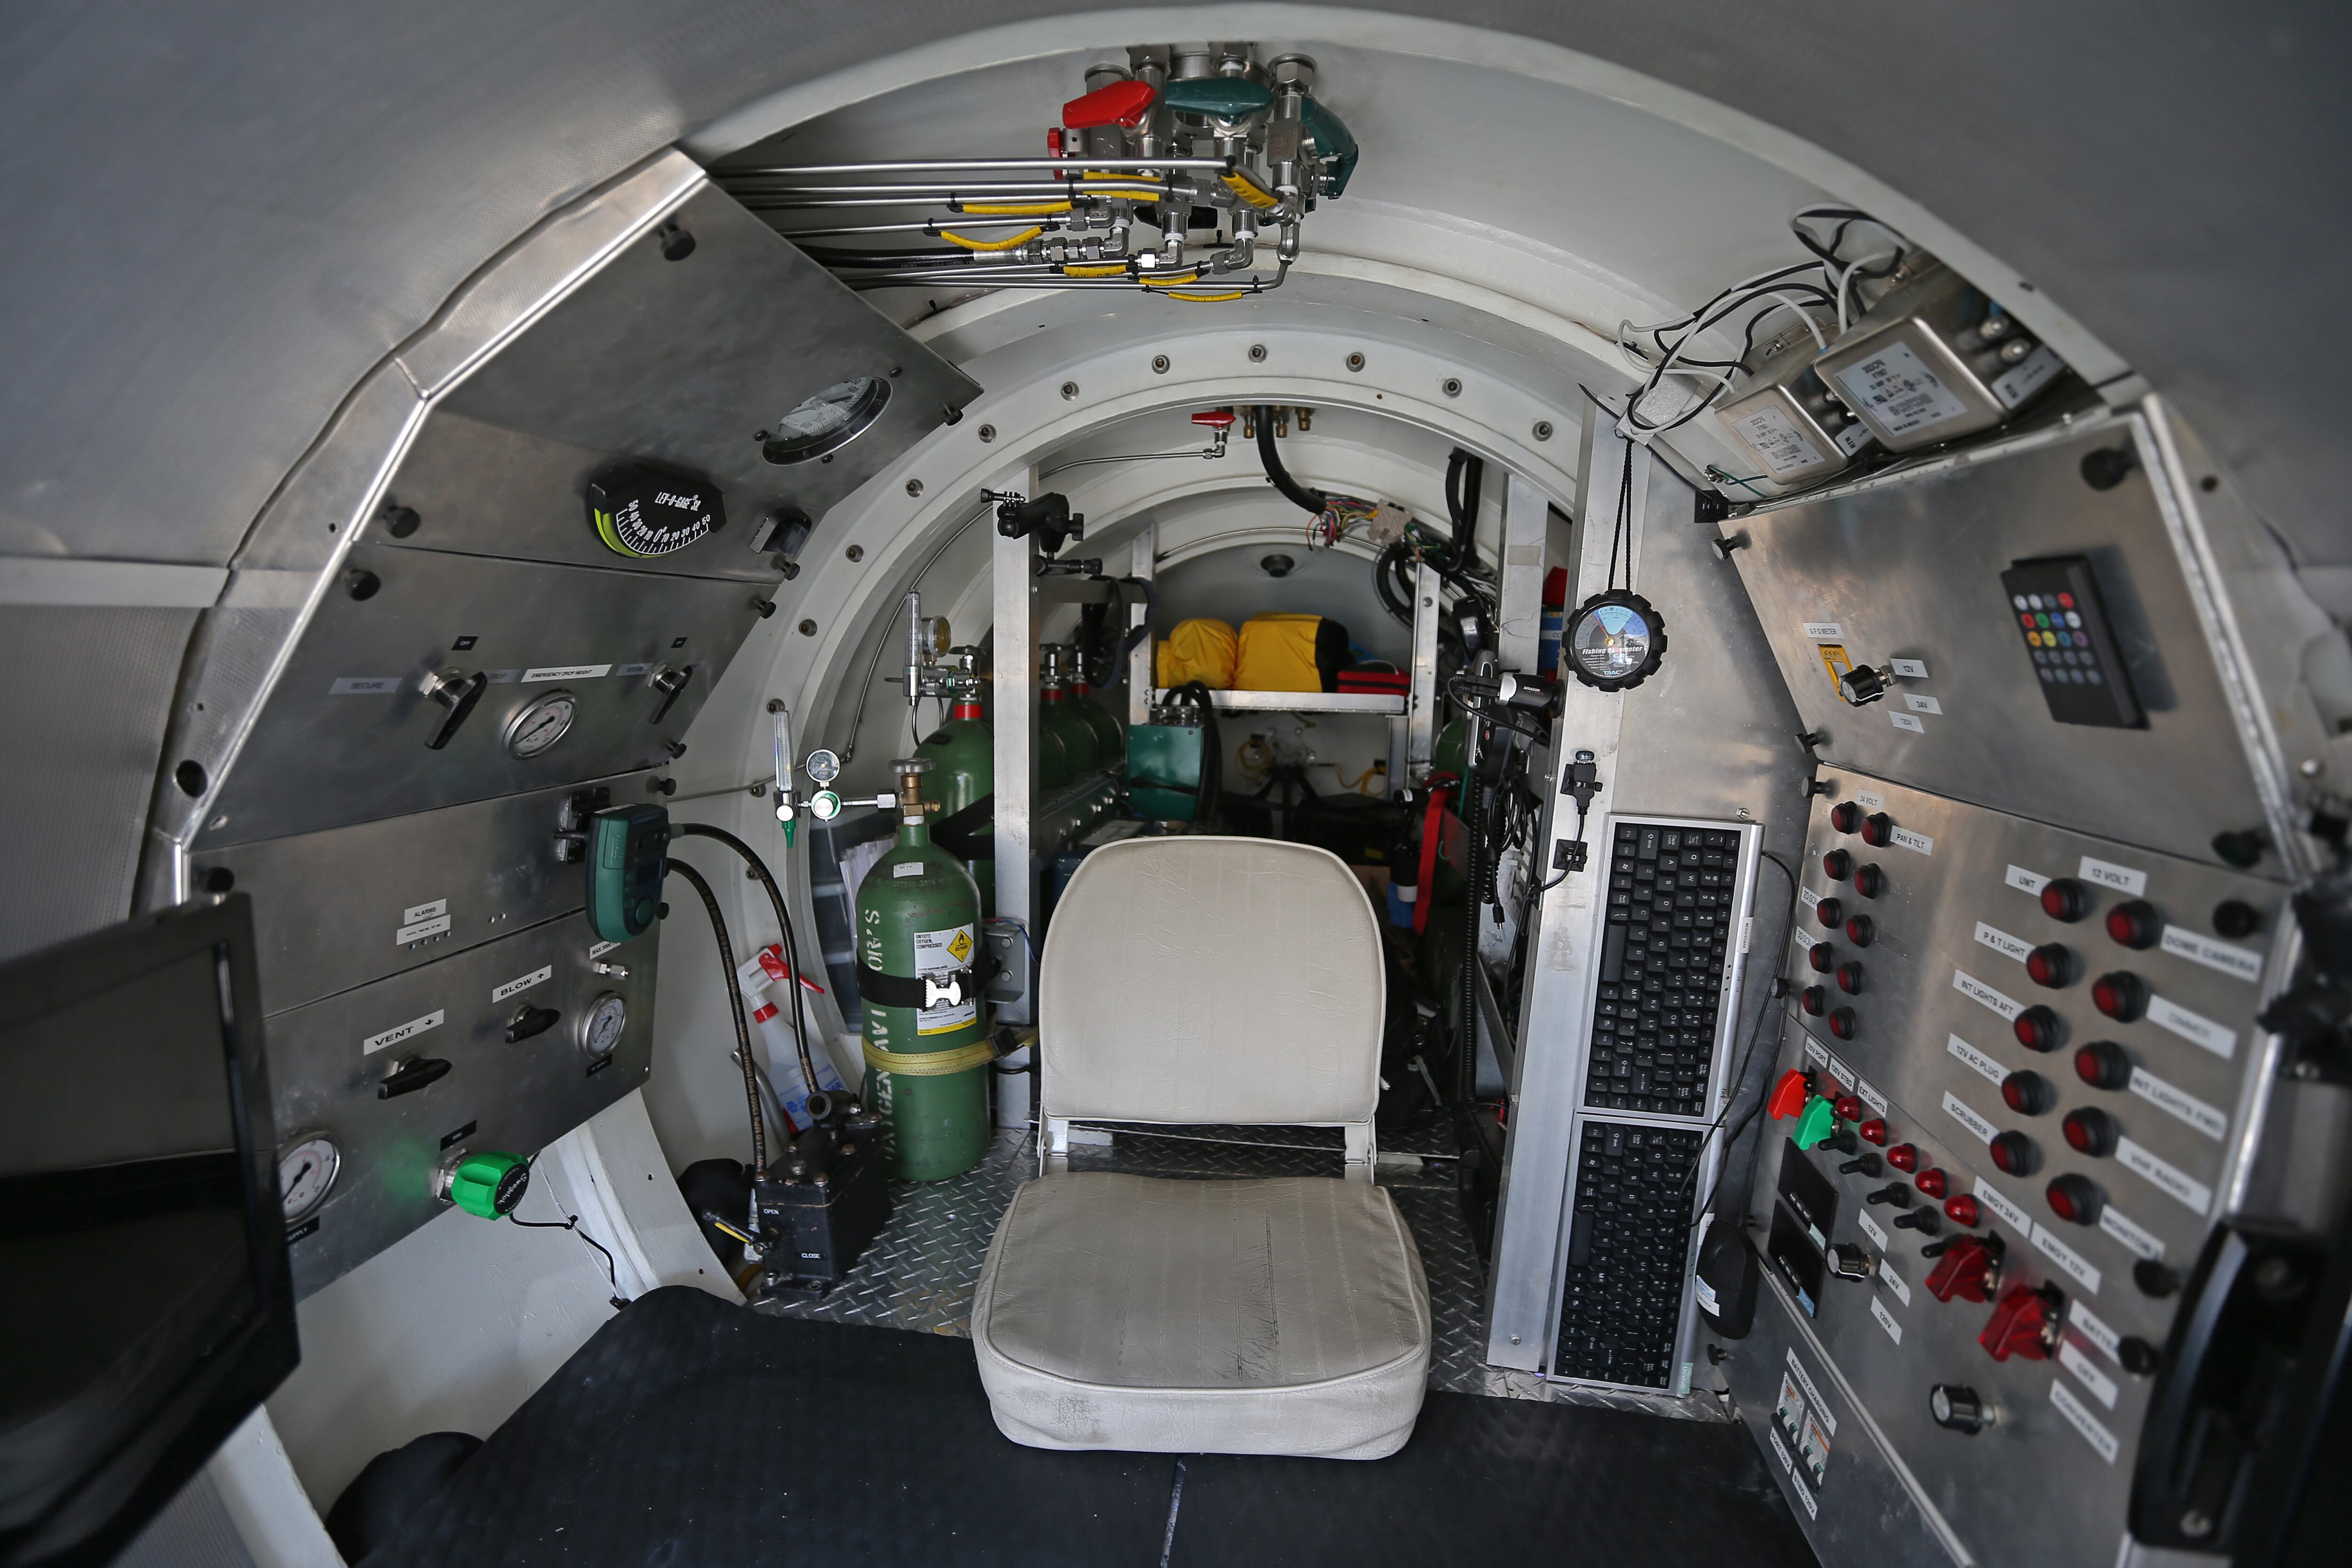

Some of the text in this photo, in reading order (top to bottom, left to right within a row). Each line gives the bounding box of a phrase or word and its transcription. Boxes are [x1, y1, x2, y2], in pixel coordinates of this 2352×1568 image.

[628, 500, 638, 511] 50
[629, 511, 640, 522] 40
[632, 518, 643, 530] 30
[702, 514, 710, 525] 50
[636, 525, 648, 536] 20
[644, 530, 653, 541] 10
[681, 527, 690, 538] 30
[691, 521, 700, 532] 40
[661, 533, 670, 543] 10
[670, 531, 680, 541] 20
[531, 670, 563, 678] EMERGENCY
[350, 681, 385, 690] SECURE
[1900, 717, 1912, 726] 120V
[1866, 796, 1878, 806] VOLT
[1896, 833, 1907, 843] PAN
[1913, 838, 1925, 849] TILT
[2092, 867, 2130, 886] 12 VOLT
[1803, 890, 1809, 900] 2D
[414, 907, 437, 918] ALARMS
[1990, 934, 1995, 943] &
[1997, 938, 2002, 946] T
[2003, 939, 2026, 956] LIGHT
[2165, 933, 2256, 973] DOME CAMERA
[500, 978, 532, 996] BLOW
[1962, 980, 2014, 1015] INT LIGHTS AFT
[374, 1026, 414, 1046] VENT
[1807, 1043, 1827, 1063] 120V PORT
[1956, 1045, 1999, 1079] 12V AC PLUG
[746, 1056, 755, 1076] MSHA
[1831, 1064, 1852, 1087] 120V STBD
[1859, 1086, 1886, 1113] EXT LIGHTS
[2132, 1072, 2149, 1089] INT
[2152, 1083, 2193, 1117] LIGHTS
[1950, 1103, 1989, 1137] SCRUBBER
[497, 1172, 527, 1205] Swagelok
[1982, 1189, 2019, 1223] EMGY 24V
[1868, 1224, 1877, 1237] 12V
[2042, 1238, 2085, 1277] EMGY 12V
[1889, 1275, 1899, 1290] 24V
[1880, 1311, 1891, 1329] 120V
[1791, 1358, 1810, 1389] BATTERY
[1808, 1385, 1829, 1424] CHARGING
[2055, 1391, 2114, 1454] CONVERTER
[1771, 1432, 1790, 1468] PORT 120V
[1794, 1474, 1815, 1514] STBD 120V
